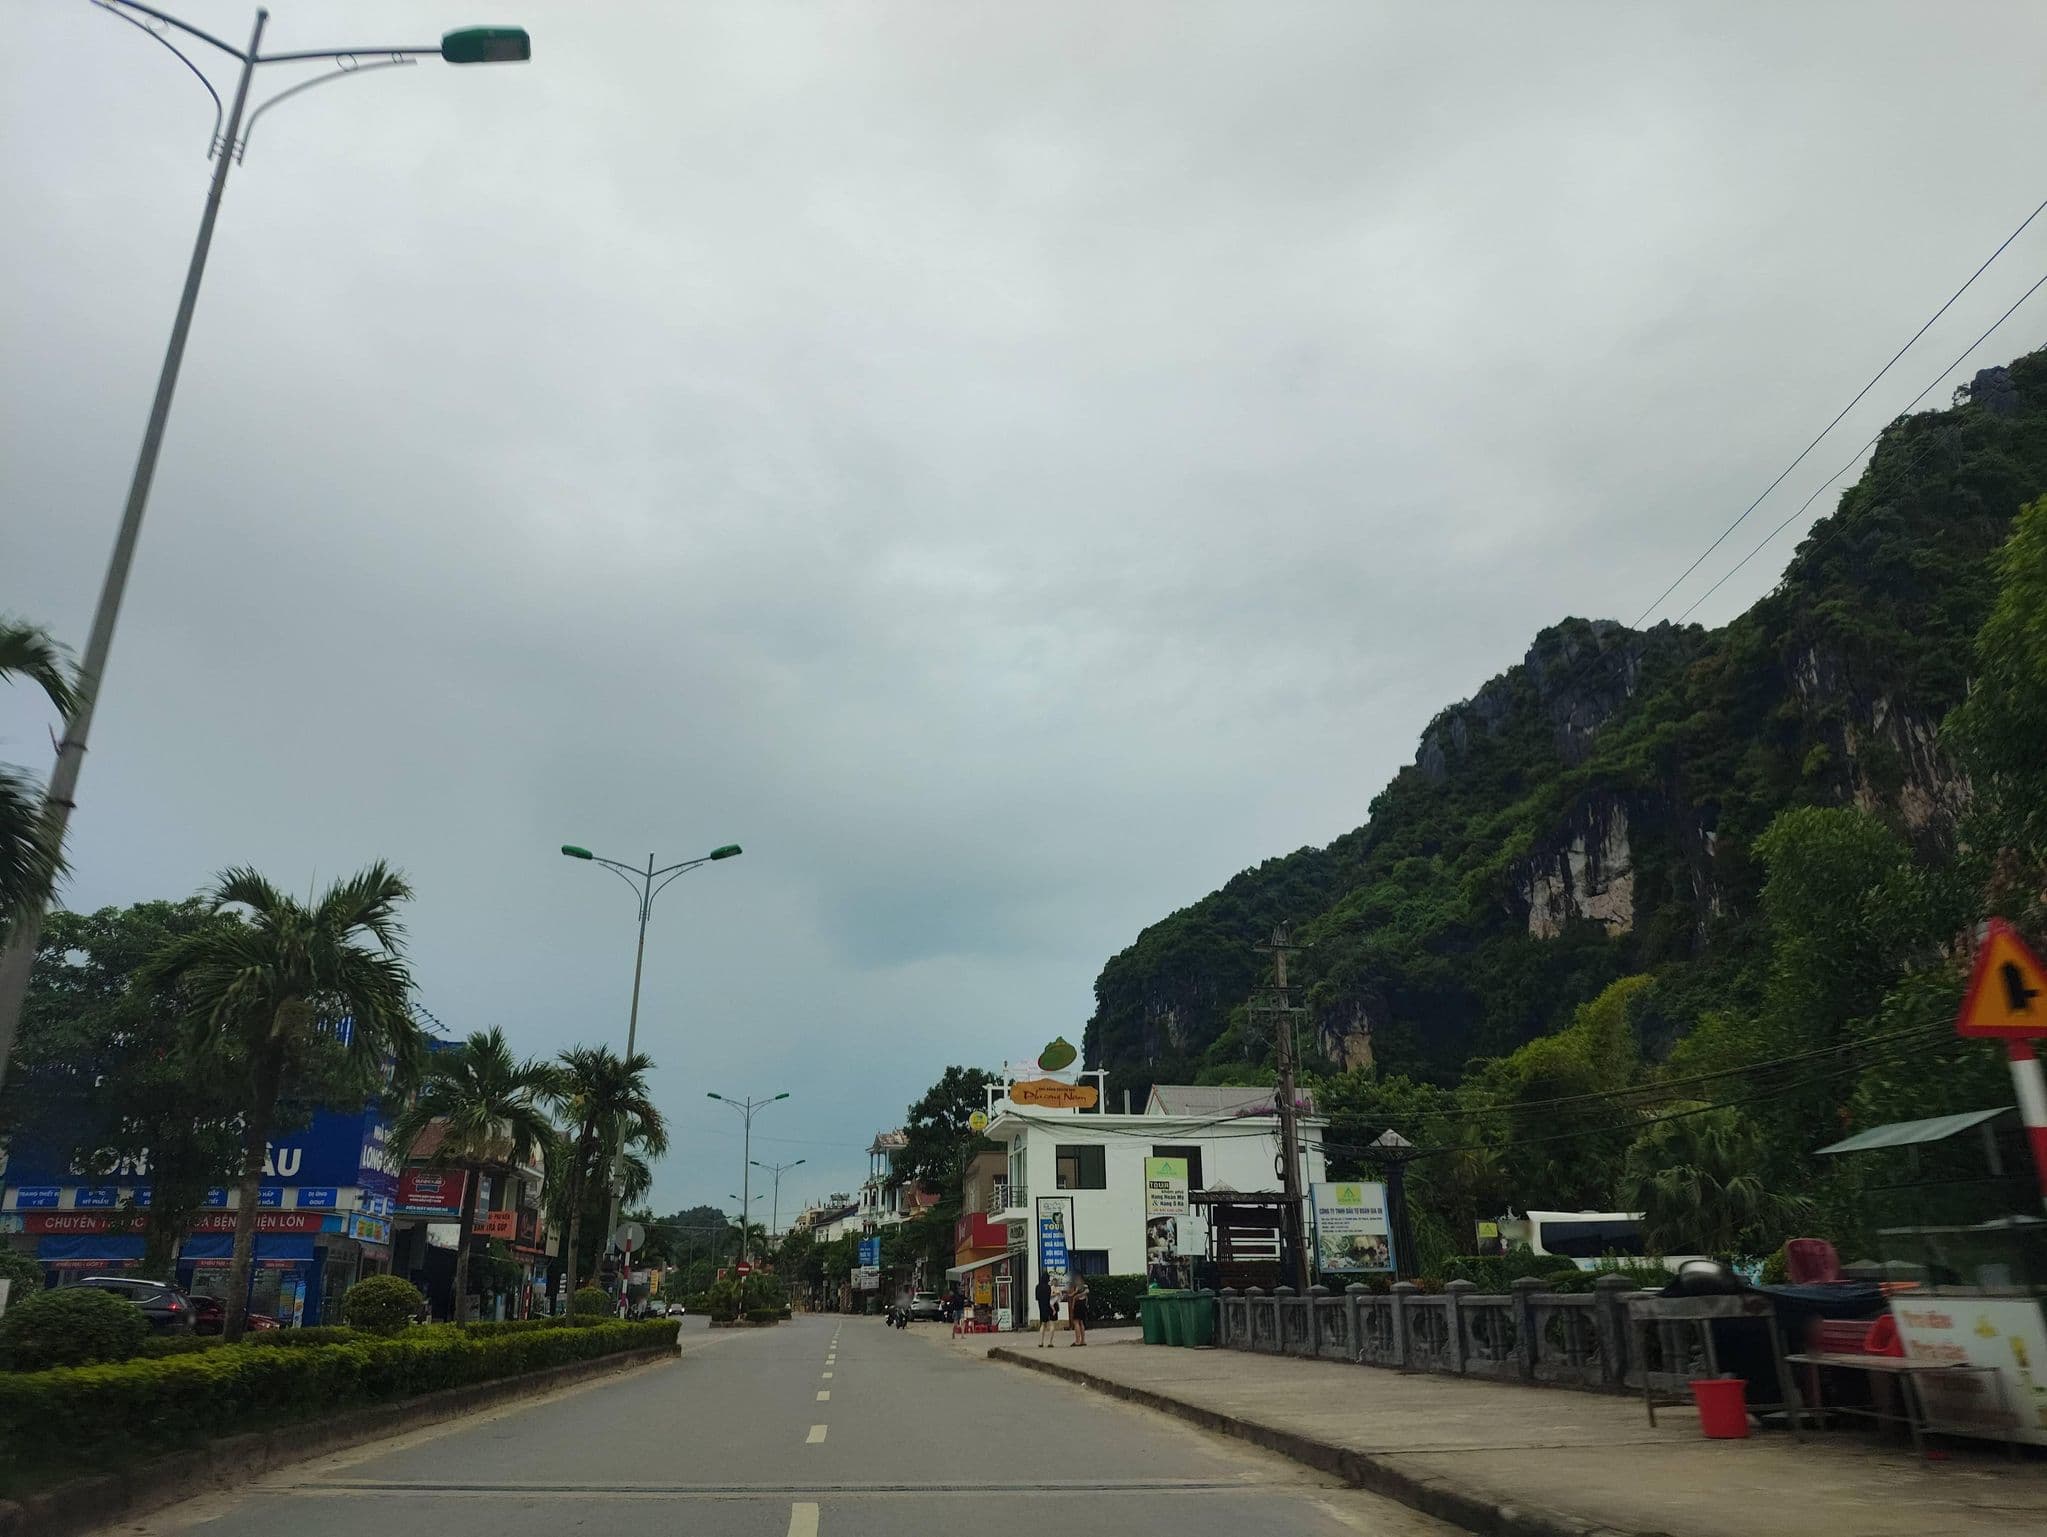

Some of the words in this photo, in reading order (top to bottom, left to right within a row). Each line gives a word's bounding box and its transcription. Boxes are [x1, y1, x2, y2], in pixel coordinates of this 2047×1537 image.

[1063, 1092, 1087, 1102] Nam
[362, 1145, 383, 1172] LONG
[45, 1214, 96, 1228] CHUYÊN
[213, 1215, 238, 1231] BỆN
[279, 1215, 305, 1228] LỚN
